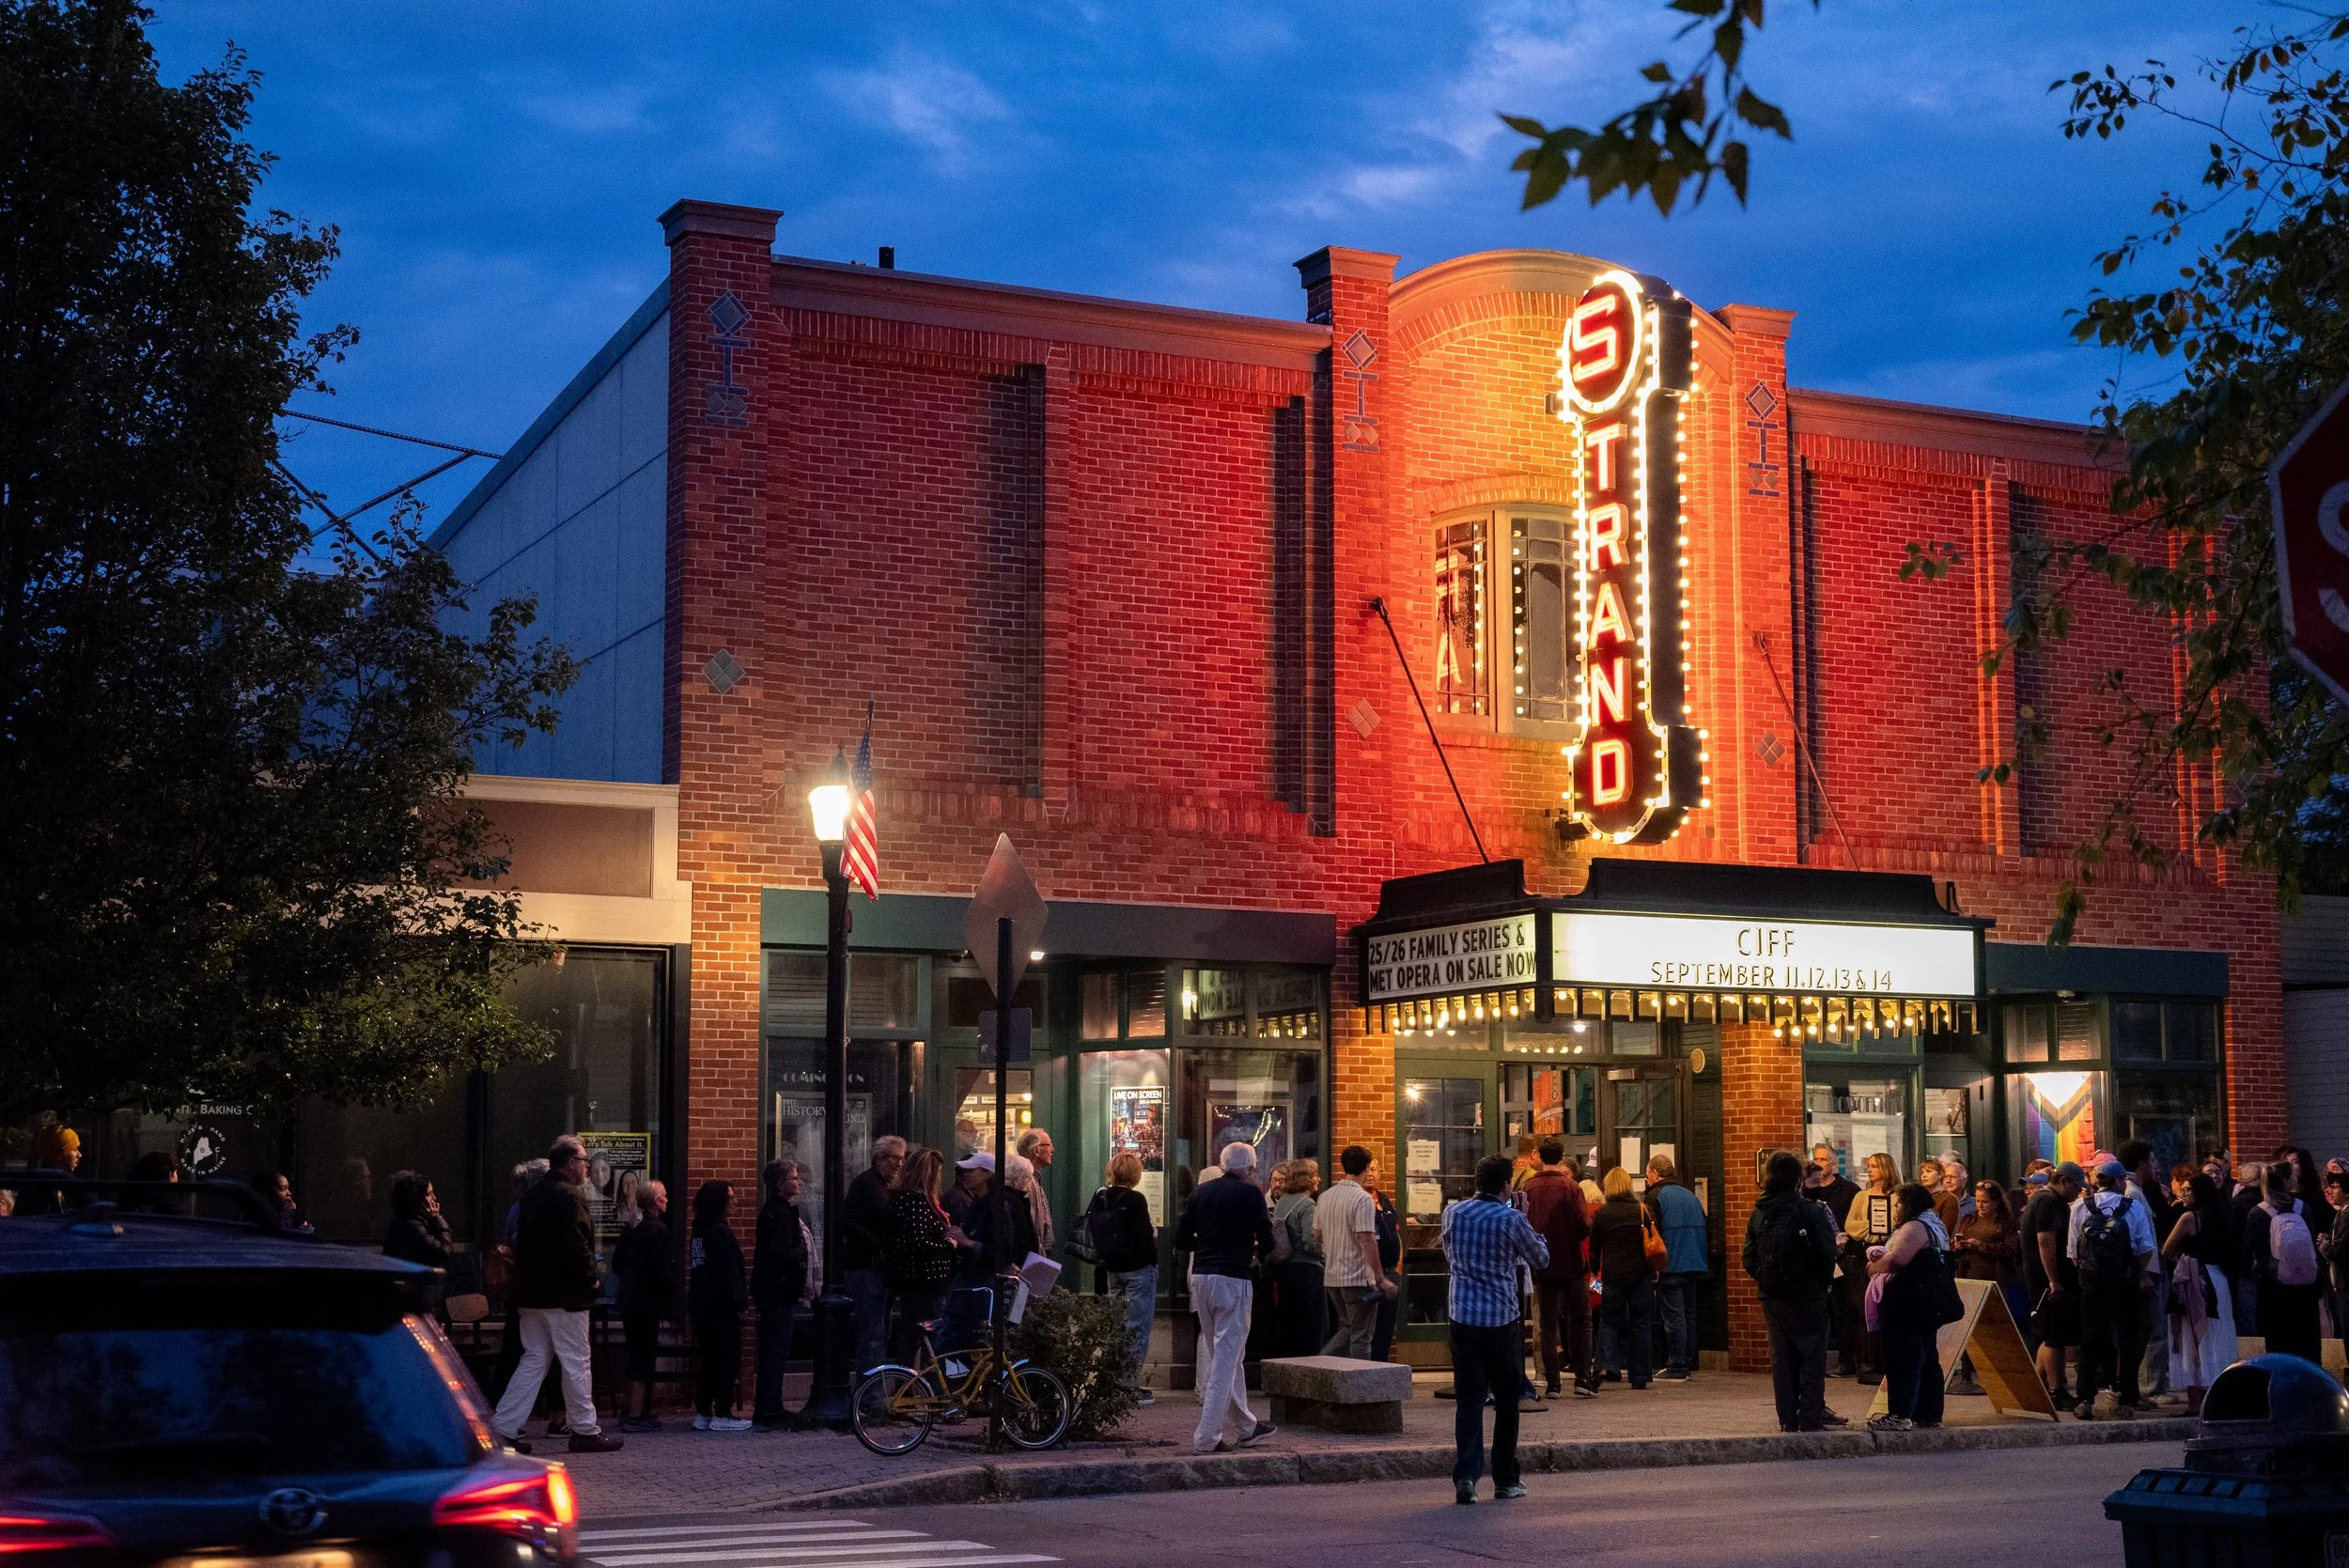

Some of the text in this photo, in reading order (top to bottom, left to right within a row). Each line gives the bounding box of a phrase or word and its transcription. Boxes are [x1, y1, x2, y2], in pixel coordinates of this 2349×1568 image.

[1571, 295, 1633, 807] STRAND
[1369, 923, 1525, 966] 25/26 FAMILY SERIES &
[1737, 927, 1796, 956] CIFF
[1369, 951, 1536, 993] MET OPERA ON SALE NOW
[1651, 961, 1775, 986] SEPTEMBER
[1113, 1090, 1162, 1100] LIVE ON SCREEN
[200, 1104, 242, 1115] BAKING
[783, 1106, 827, 1116] HISTORY
